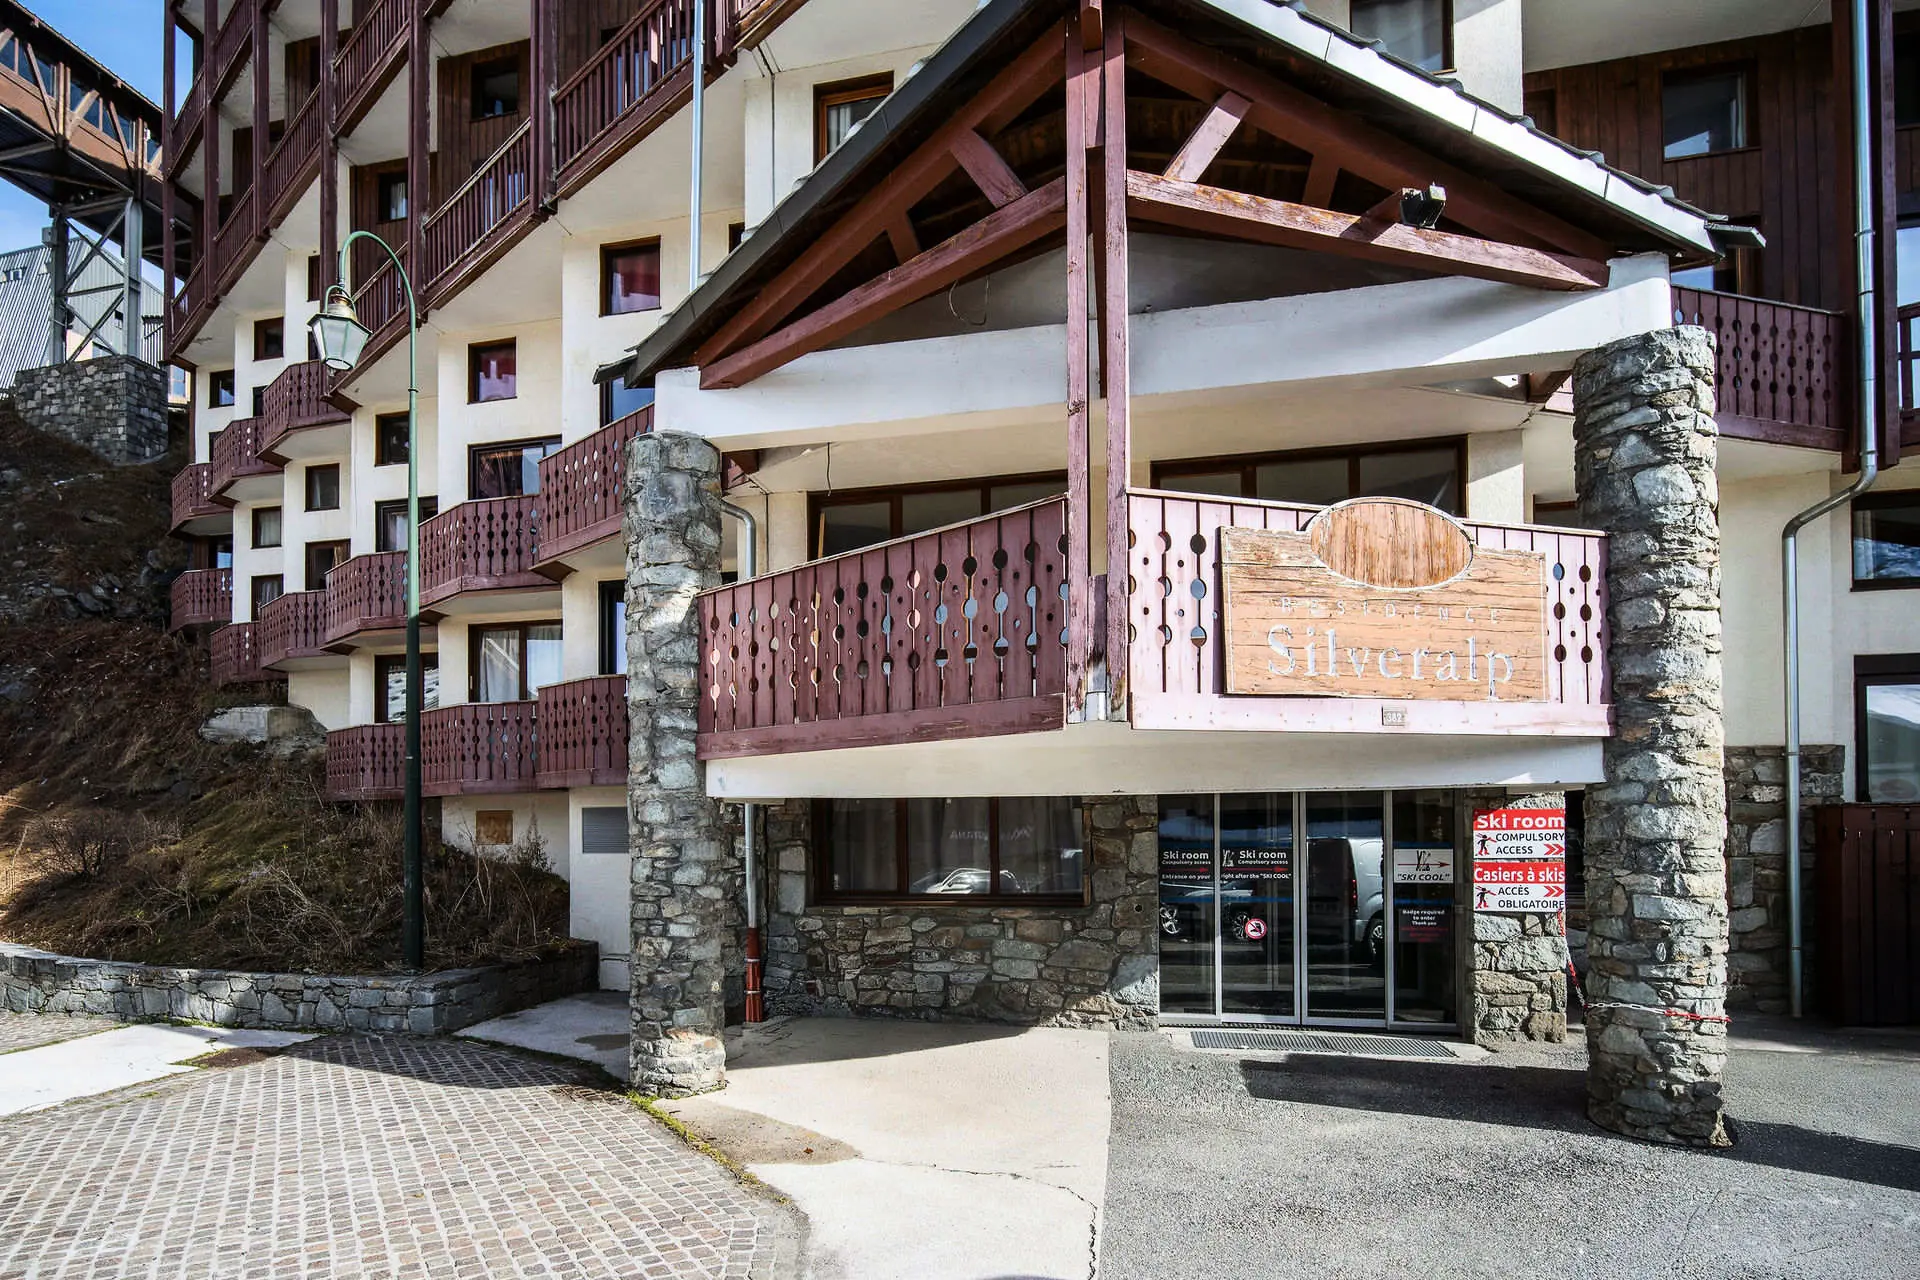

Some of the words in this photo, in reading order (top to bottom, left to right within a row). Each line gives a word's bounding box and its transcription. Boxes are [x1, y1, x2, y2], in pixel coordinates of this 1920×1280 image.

[1267, 624, 1513, 701] Silveralp
[1477, 814, 1507, 829] Ski
[1513, 817, 1565, 829] room
[1496, 832, 1565, 842] COMPULSORY
[1163, 850, 1179, 860] Ski
[1181, 852, 1209, 860] room
[1239, 850, 1256, 859] Ski
[1496, 846, 1533, 855] ACCESS
[1474, 866, 1523, 882] Casiers
[1527, 866, 1535, 882] à
[1538, 867, 1565, 882] skis
[1498, 884, 1530, 895] ACCÈS
[1498, 899, 1565, 909] OBLIGATOIRE
